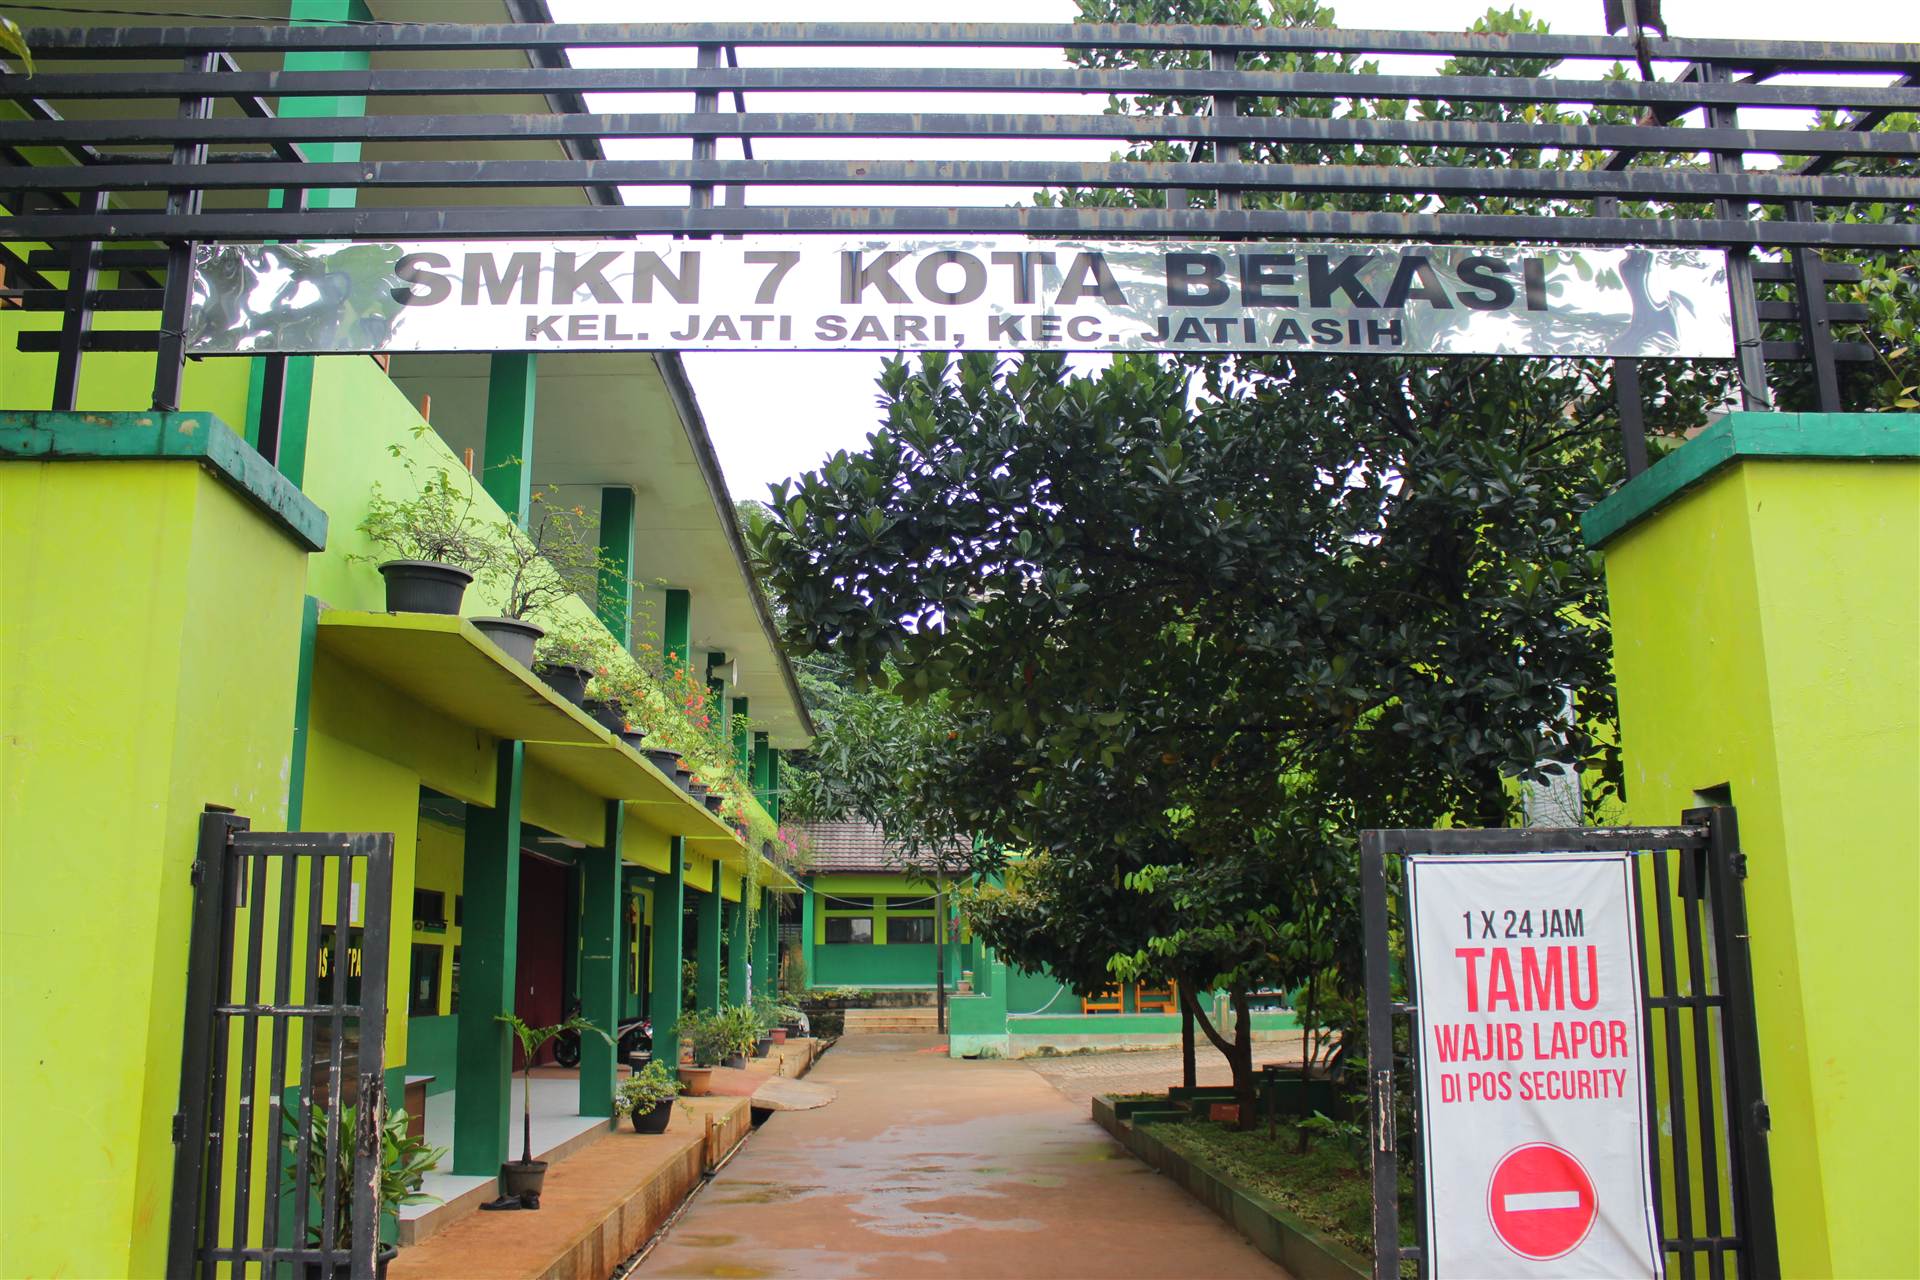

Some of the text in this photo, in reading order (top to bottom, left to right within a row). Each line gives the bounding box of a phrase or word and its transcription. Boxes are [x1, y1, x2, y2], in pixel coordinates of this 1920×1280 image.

[390, 250, 1549, 312] SMKN 7 KOTA BEKASI
[525, 315, 1402, 349] KEL. JATI SARI, KEC. JATI ASIH
[1462, 908, 1585, 939] 1 X 24 JAM
[1455, 945, 1600, 1013] TAMU
[1434, 1019, 1629, 1063] WAJIB LAPOR
[1441, 1068, 1627, 1104] DI POS SECURITY
